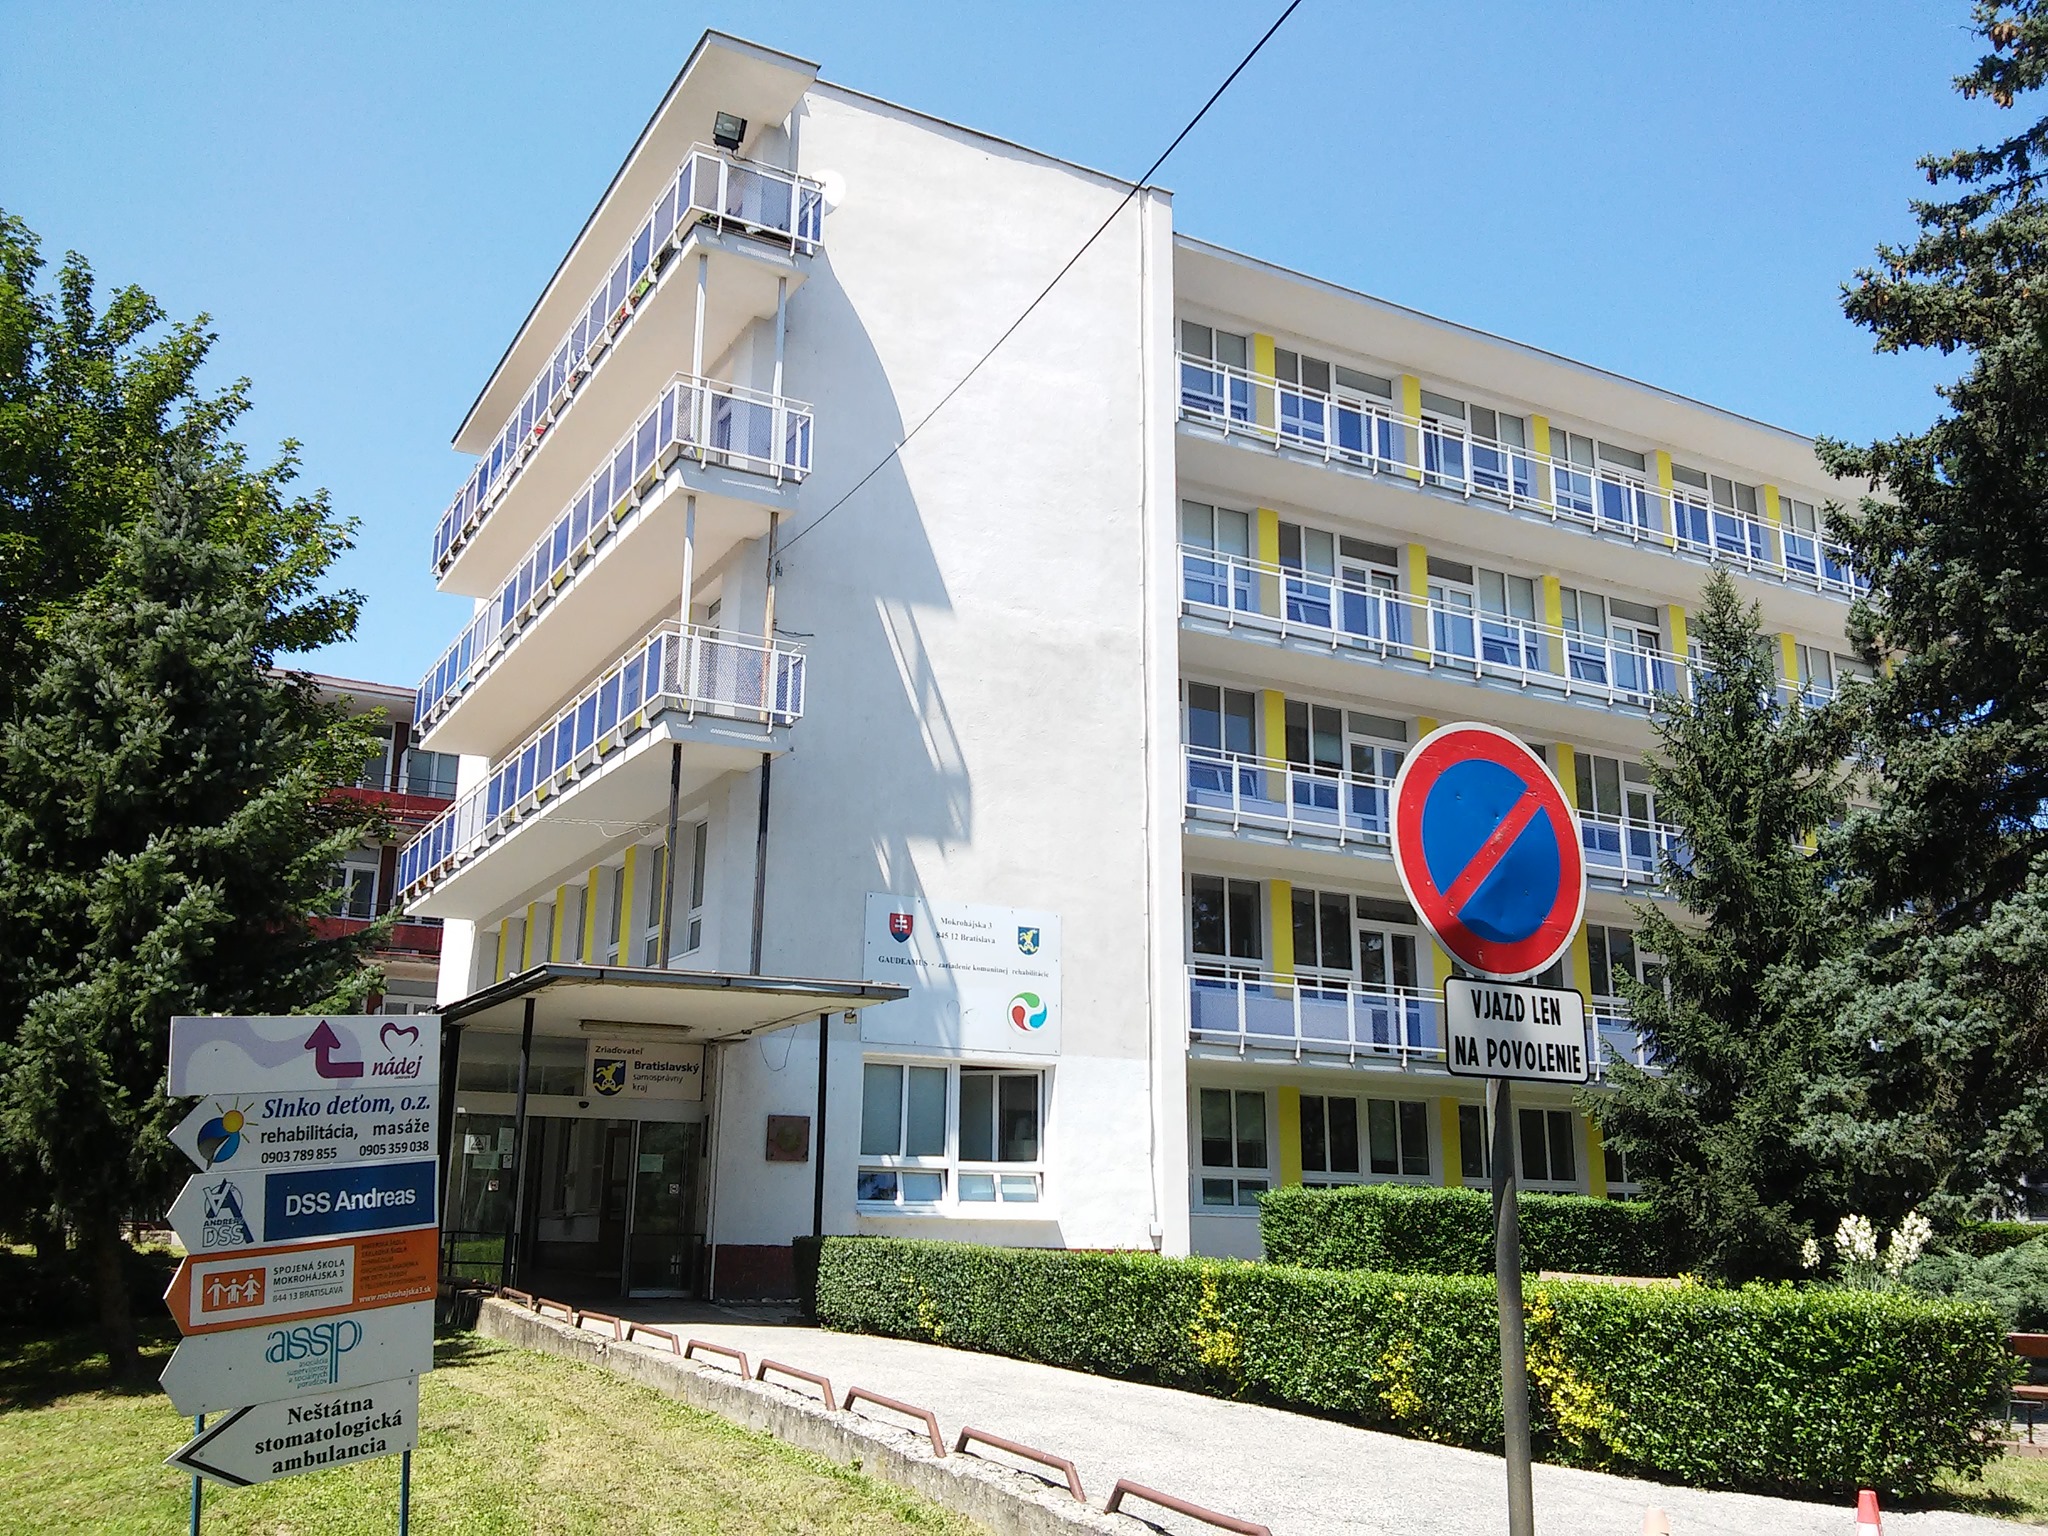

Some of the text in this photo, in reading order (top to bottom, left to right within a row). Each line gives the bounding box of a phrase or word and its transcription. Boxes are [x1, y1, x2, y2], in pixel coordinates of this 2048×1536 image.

[940, 916, 987, 930] Mokrohájska
[936, 931, 996, 945] 845 12 Bratislava
[878, 954, 929, 967] GAUDEAMUS
[938, 961, 971, 971] zariadenie
[972, 964, 1009, 975] komunitnej
[1471, 989, 1562, 1026] VJAZD LEN
[595, 1045, 645, 1055] Zriaďovateľ
[1455, 1035, 1581, 1074] NA POVOLENIE
[371, 1055, 423, 1079] nádej
[632, 1073, 683, 1084] samosprávny
[634, 1060, 700, 1074] Bratislavský
[632, 1083, 648, 1093] kraj
[262, 1094, 430, 1119] Slnko deťom, o.z.
[261, 1118, 430, 1144] rehabilitácia, masáže
[261, 1140, 429, 1164] 0903 789 855 0905 359 038
[285, 1187, 417, 1217] DSS Andreas
[202, 1224, 245, 1248] DSS
[273, 1261, 315, 1276] SPOJENÁ
[317, 1258, 345, 1270] ŠKOLA
[273, 1269, 345, 1286] MOKROHÁJSKA 3
[289, 1291, 298, 1300] 13
[299, 1285, 344, 1299] BRATISLAVA
[359, 1285, 432, 1303] www.mokrohajska3.sk
[265, 1320, 362, 1385] assp
[287, 1398, 374, 1425] Neštátna
[255, 1409, 403, 1455] stomatologická
[272, 1437, 387, 1474] ambulancia
